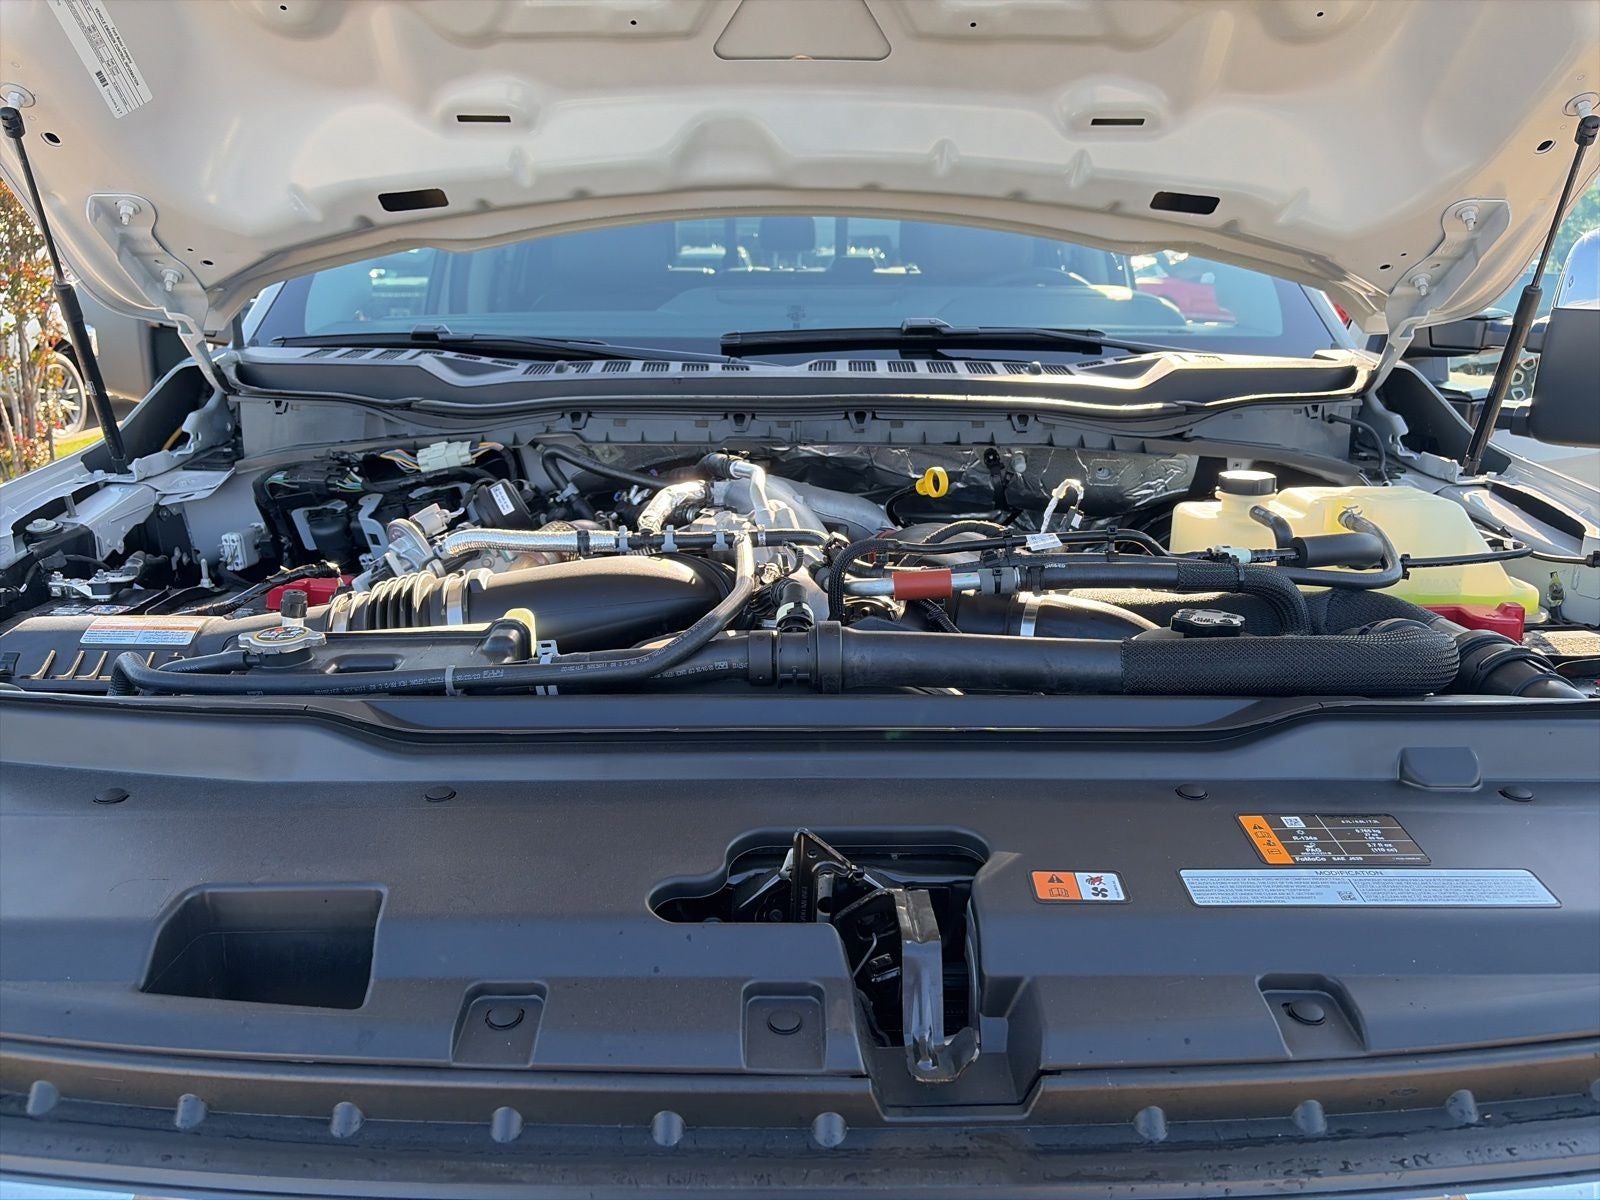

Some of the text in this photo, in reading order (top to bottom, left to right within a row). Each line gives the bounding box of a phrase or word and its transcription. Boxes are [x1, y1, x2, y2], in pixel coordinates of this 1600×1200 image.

[95, 8, 106, 24] VEHICLE
[104, 25, 116, 43] EMISSION
[114, 43, 126, 61] CONTROL
[125, 62, 140, 86] INFORMATION
[121, 46, 133, 63] Company
